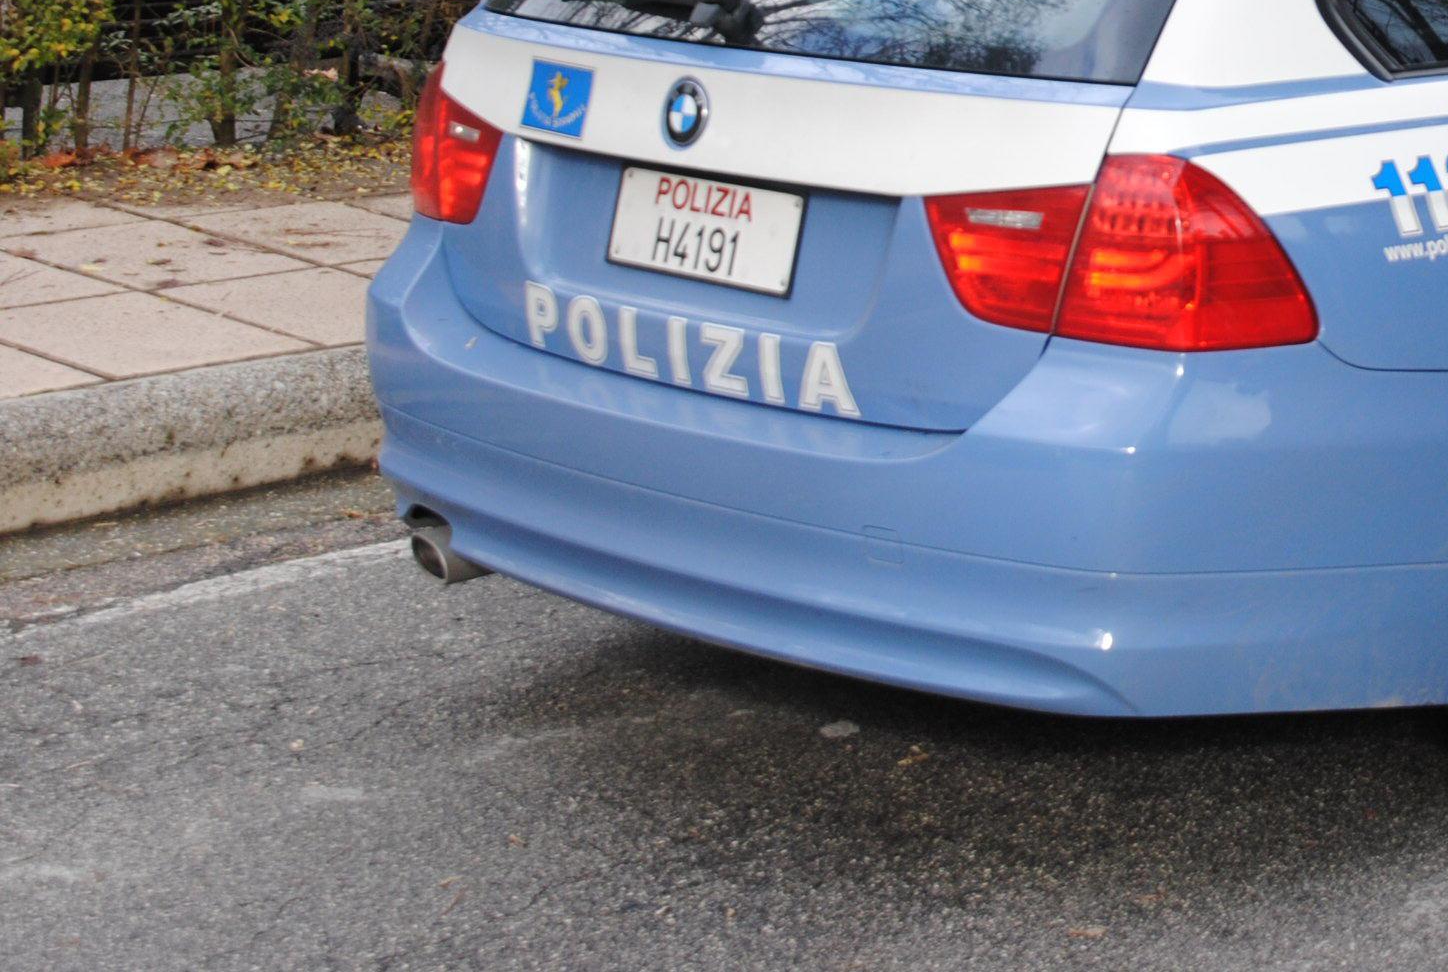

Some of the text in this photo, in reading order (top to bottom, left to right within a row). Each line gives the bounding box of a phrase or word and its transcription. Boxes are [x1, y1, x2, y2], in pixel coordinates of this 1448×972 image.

[655, 176, 753, 222] POLIZIA
[651, 216, 740, 276] H4191
[525, 280, 862, 418] POLIZIA
